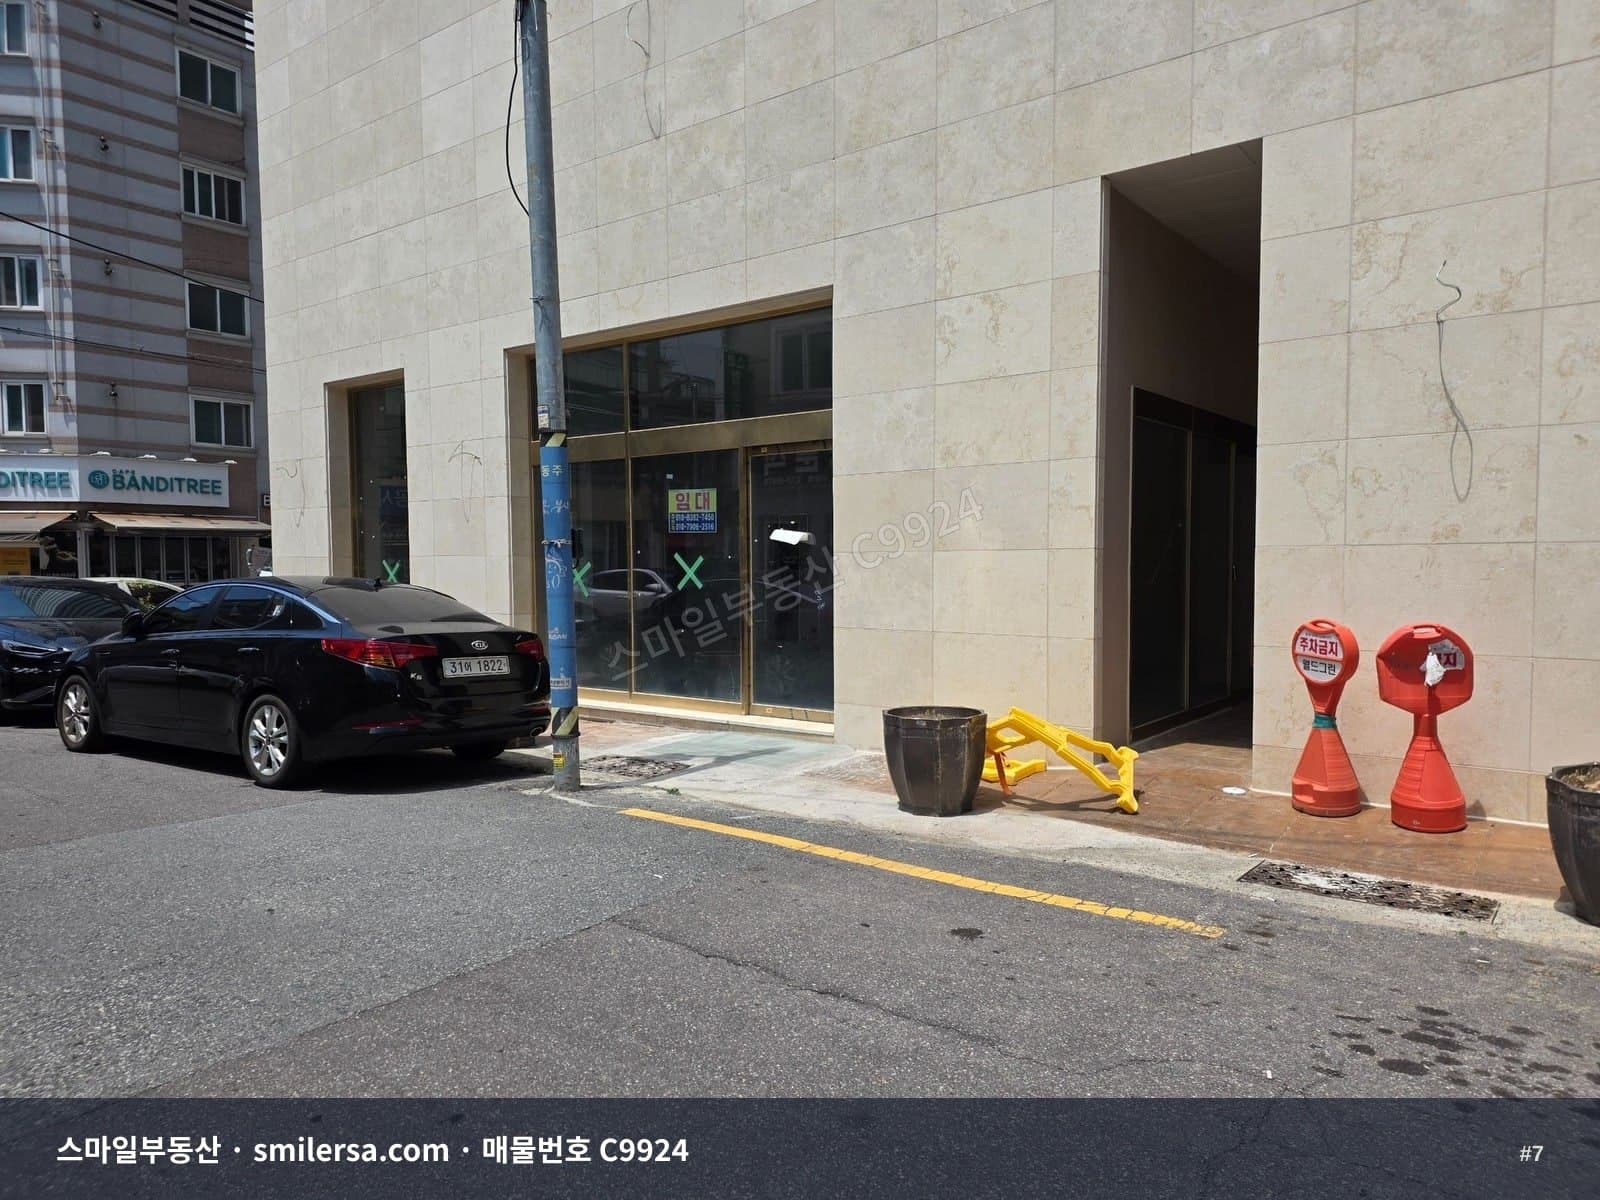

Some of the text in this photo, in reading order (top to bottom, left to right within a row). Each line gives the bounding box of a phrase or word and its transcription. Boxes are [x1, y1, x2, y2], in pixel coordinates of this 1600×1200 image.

[675, 492, 710, 511] 임대
[1300, 636, 1338, 657] 주차금지
[477, 659, 504, 673] 1822
